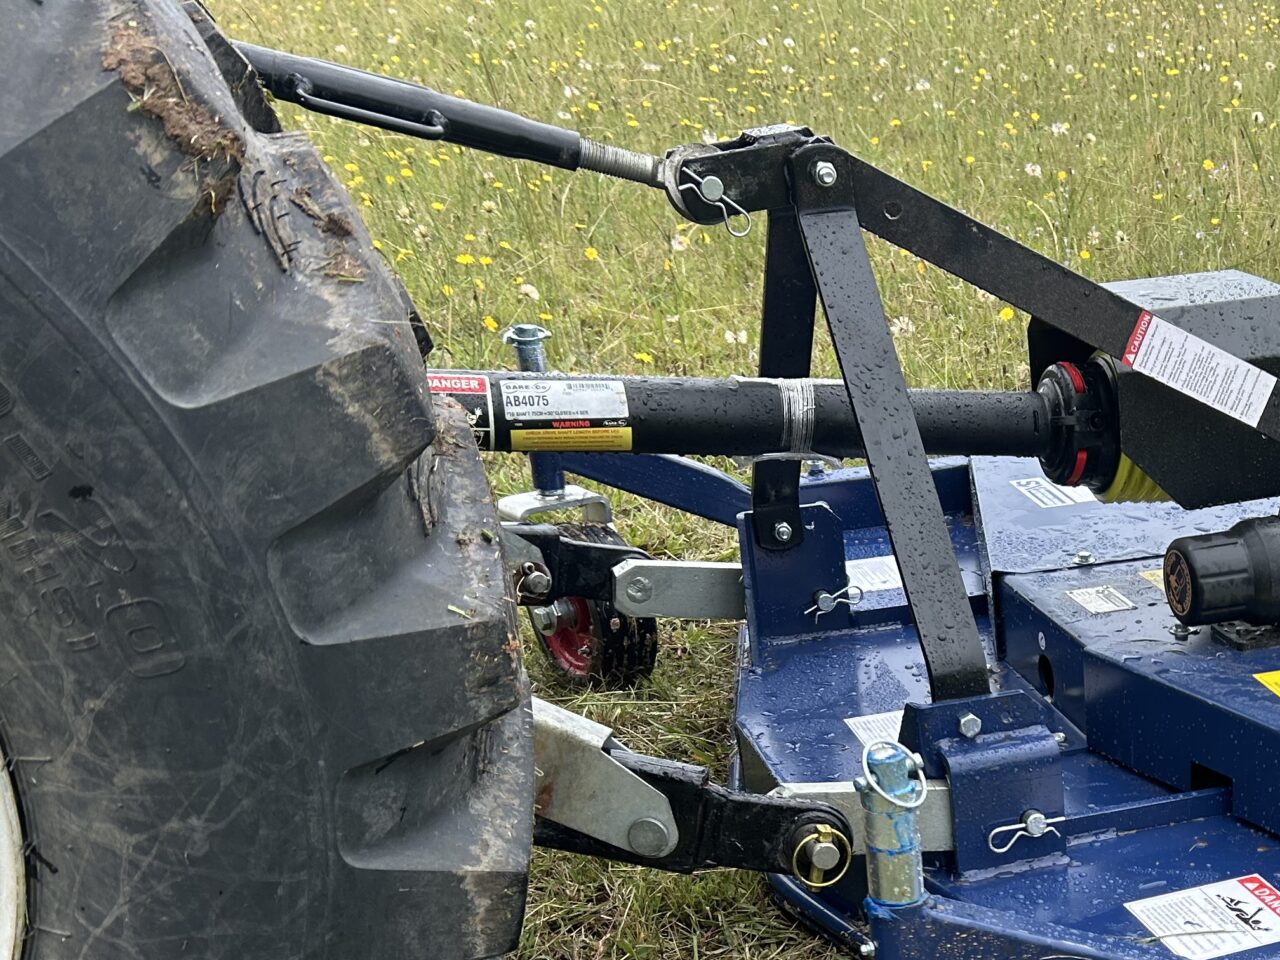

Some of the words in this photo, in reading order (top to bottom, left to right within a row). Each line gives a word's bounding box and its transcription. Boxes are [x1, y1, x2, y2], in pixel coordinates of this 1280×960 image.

[1131, 315, 1152, 353] CAUTION
[505, 396, 549, 408] AB4075
[552, 420, 591, 429] WARNING
